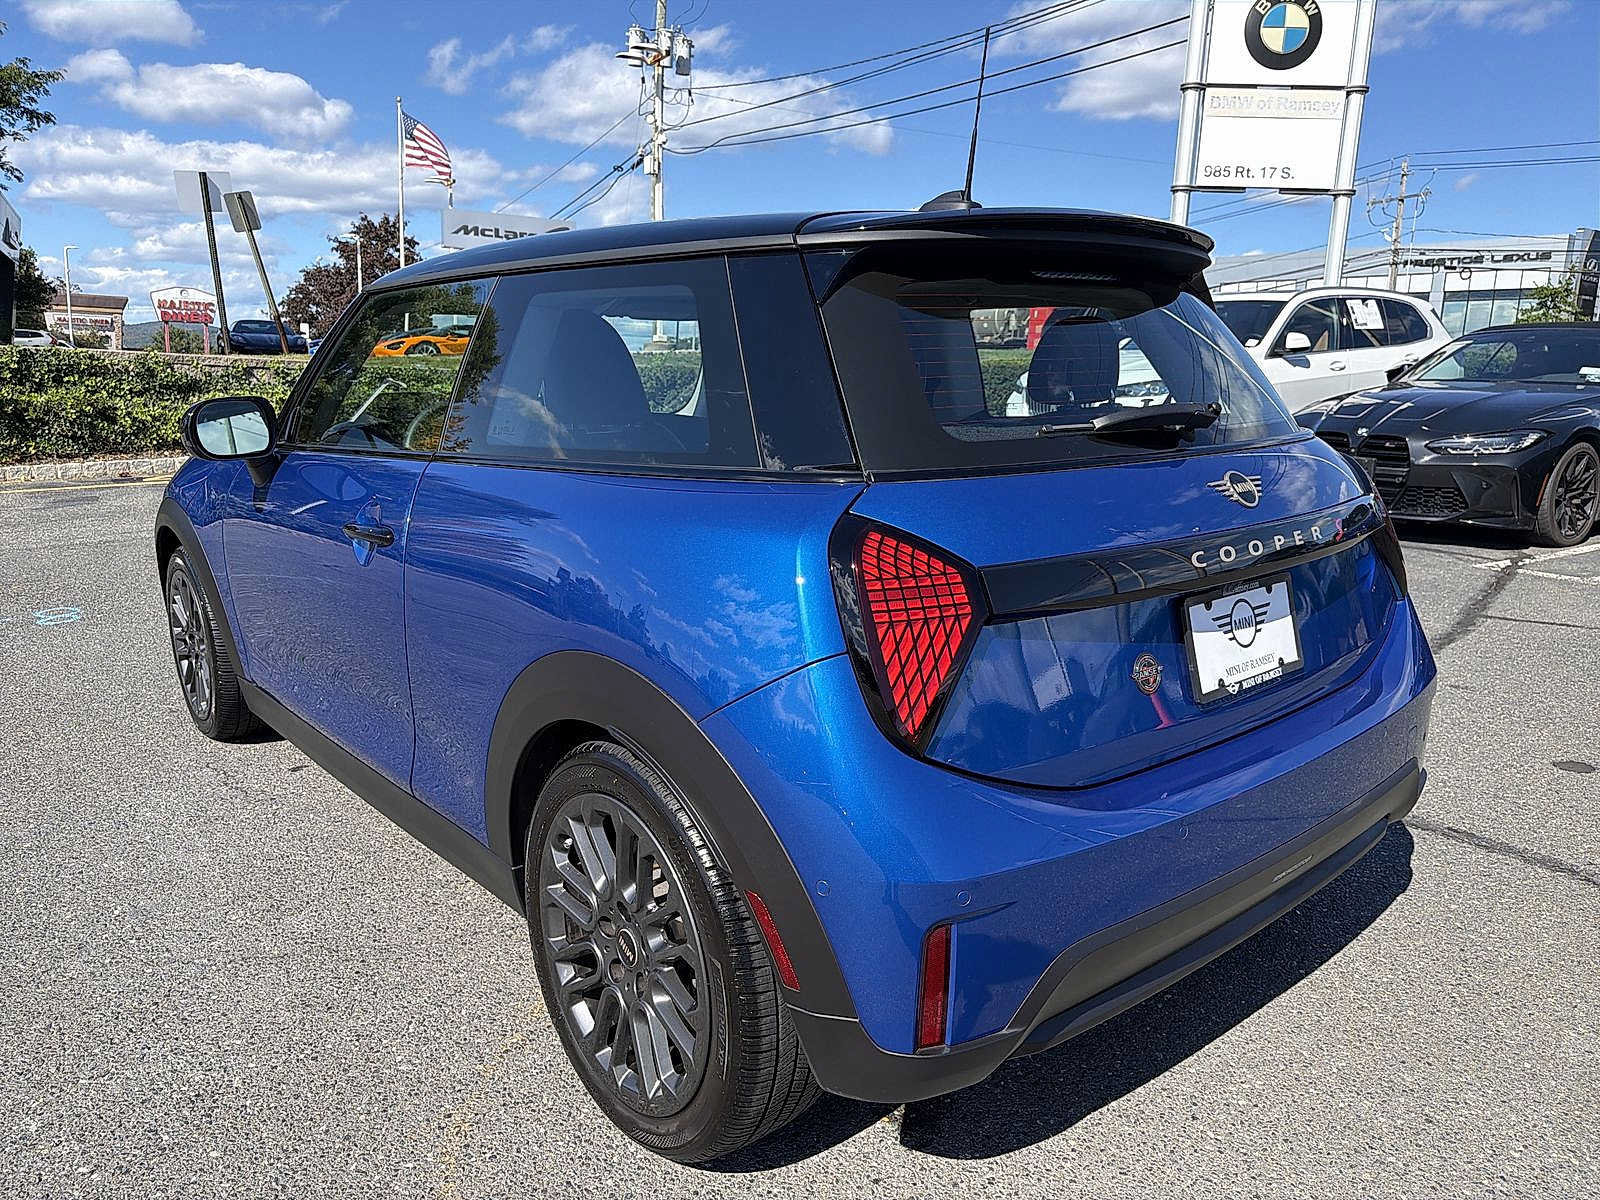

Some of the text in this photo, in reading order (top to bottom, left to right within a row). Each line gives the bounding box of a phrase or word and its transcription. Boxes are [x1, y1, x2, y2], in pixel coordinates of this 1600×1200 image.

[1255, 0, 1319, 16] BW
[1209, 96, 1341, 115] BMW of Ramsey
[1204, 165, 1295, 179] 985 Rt. 17 S.
[1491, 251, 1552, 264] LEXUS
[157, 299, 216, 313] MAJESTIC
[161, 310, 214, 324] DINER
[1191, 517, 1345, 568] COOPER S
[1233, 615, 1255, 631] MINI
[1226, 664, 1241, 676] MINI
[1250, 653, 1276, 669] RAMSEY
